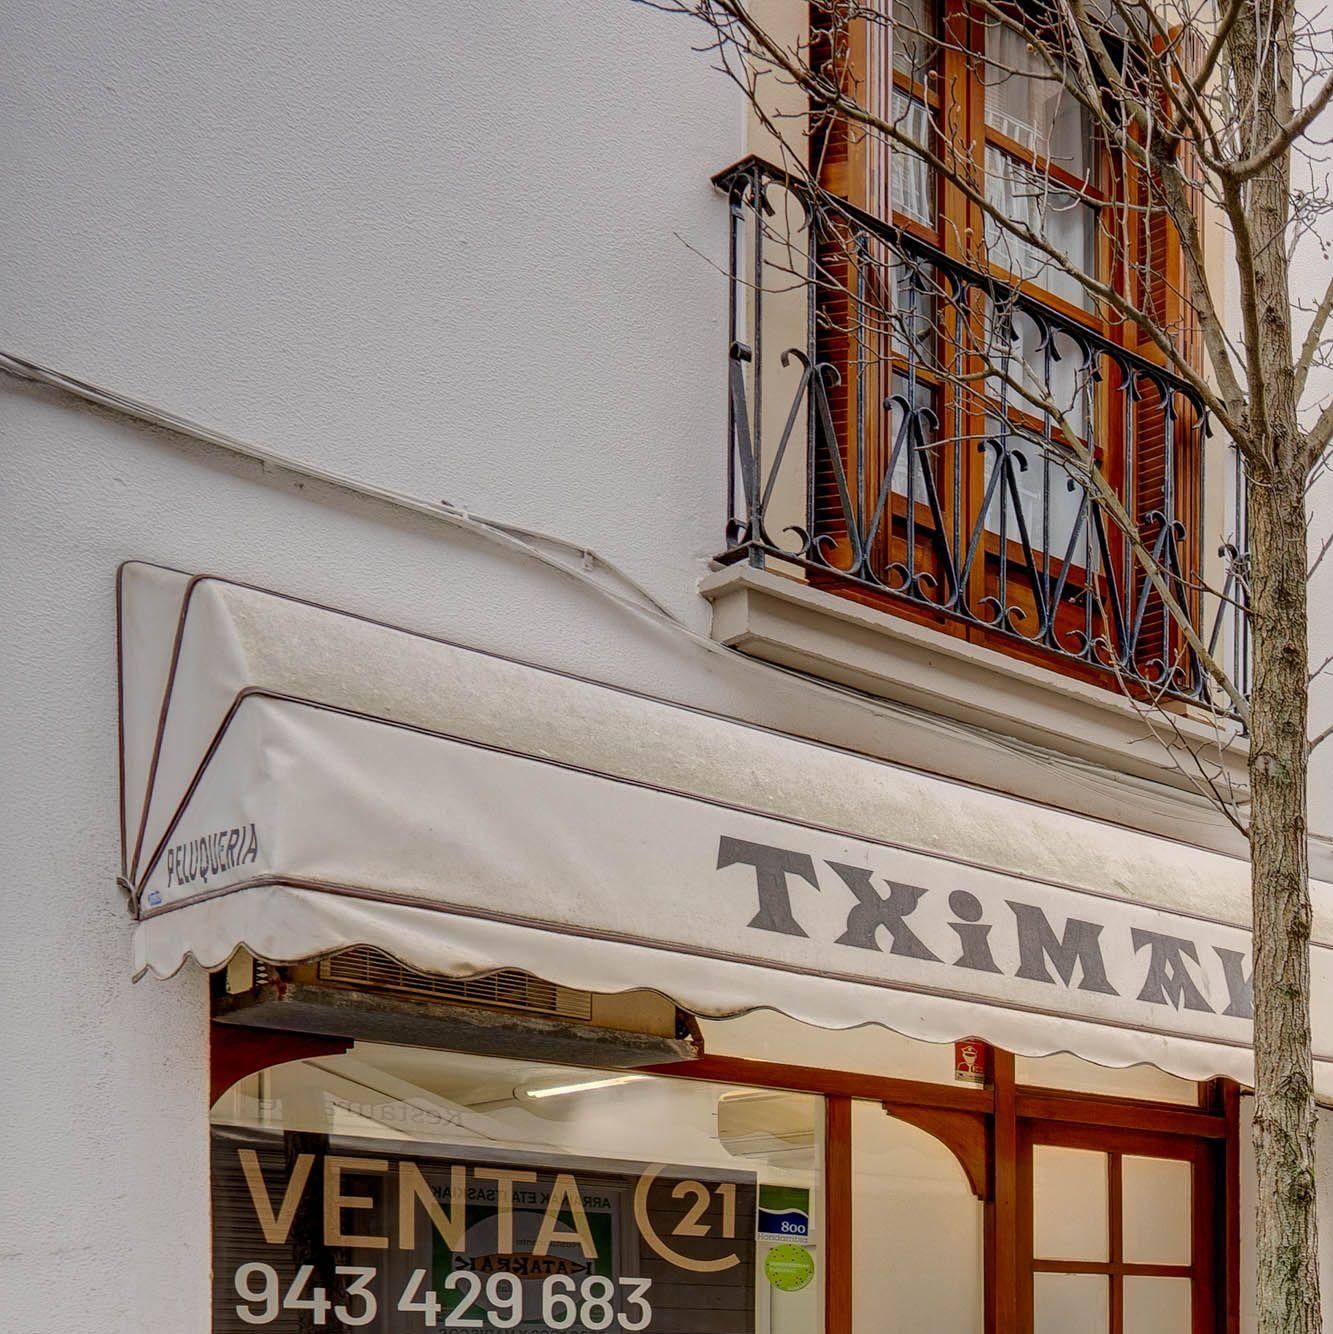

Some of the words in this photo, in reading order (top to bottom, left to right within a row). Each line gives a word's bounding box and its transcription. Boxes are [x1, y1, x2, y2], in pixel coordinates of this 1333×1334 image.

[167, 823, 258, 889] PELUQUERIA
[237, 1148, 598, 1259] VENTA
[781, 1220, 806, 1234] 800
[234, 1262, 377, 1326] 943
[398, 1269, 523, 1328] 429
[541, 1273, 653, 1331] 683
